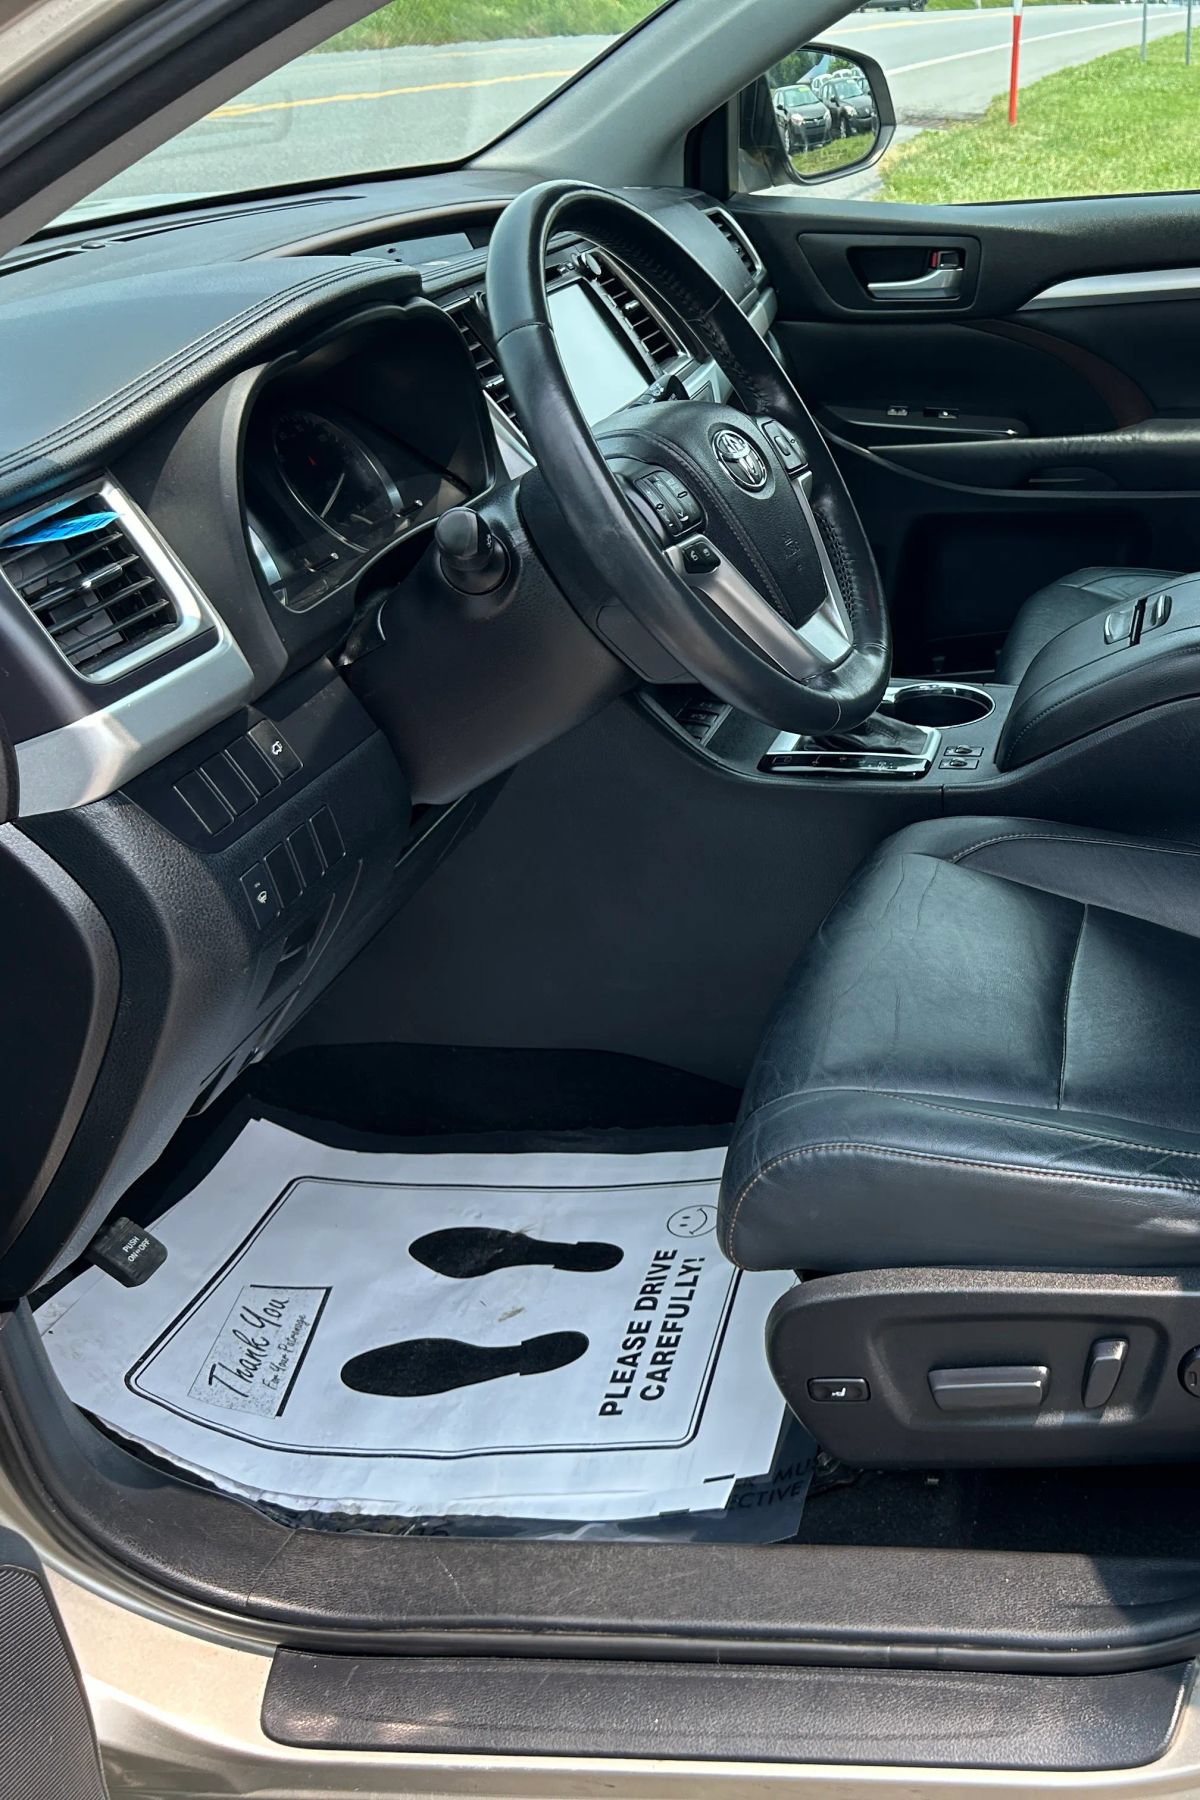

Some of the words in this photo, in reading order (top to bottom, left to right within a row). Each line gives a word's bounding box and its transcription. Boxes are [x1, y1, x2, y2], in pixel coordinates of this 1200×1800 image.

[122, 1235, 140, 1253] PUSH
[208, 1328, 270, 1398] Thank
[239, 1296, 290, 1329] You
[277, 1314, 311, 1354] Patronage
[598, 1319, 653, 1417] PLEASE
[634, 1249, 679, 1312] DRIVE
[639, 1257, 706, 1402] CAREFULLY!
[262, 1374, 281, 1391] For
[269, 1353, 290, 1373] Your
